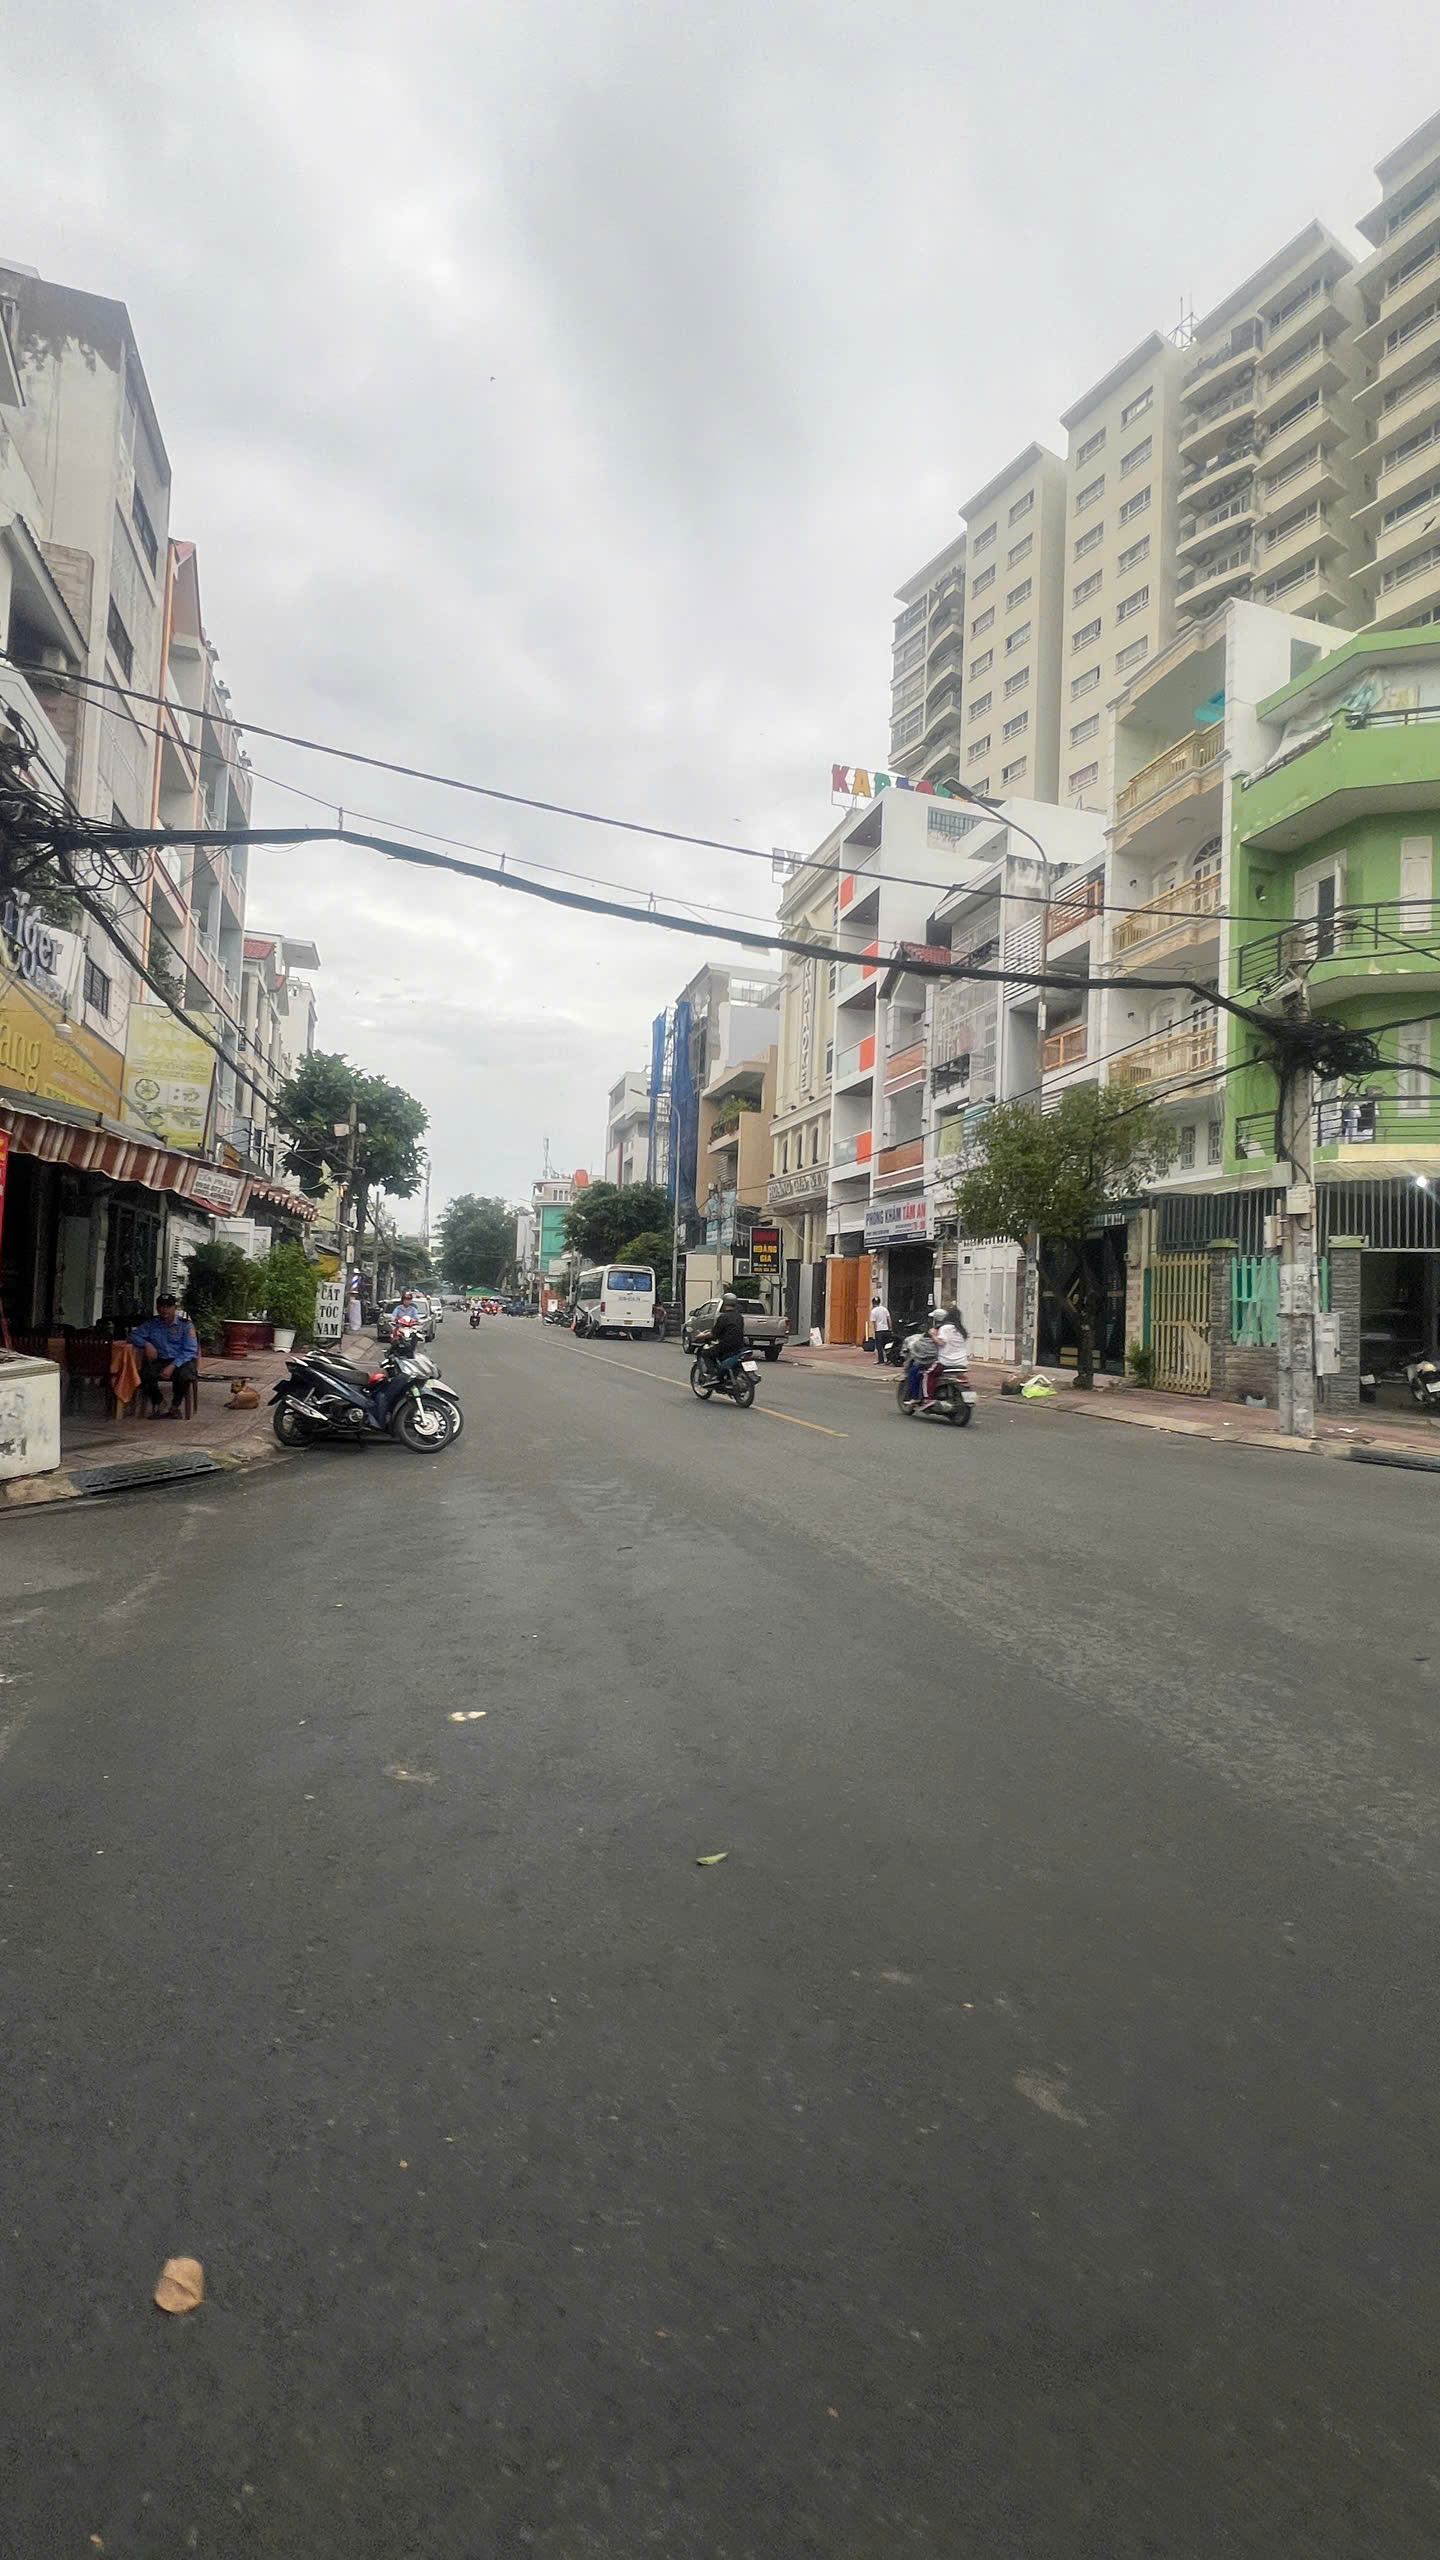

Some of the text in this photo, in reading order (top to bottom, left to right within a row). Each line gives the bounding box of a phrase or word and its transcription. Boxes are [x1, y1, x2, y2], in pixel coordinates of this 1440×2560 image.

[832, 763, 969, 803] KARO
[320, 1303, 340, 1319] TÓC
[317, 1322, 339, 1336] NAM
